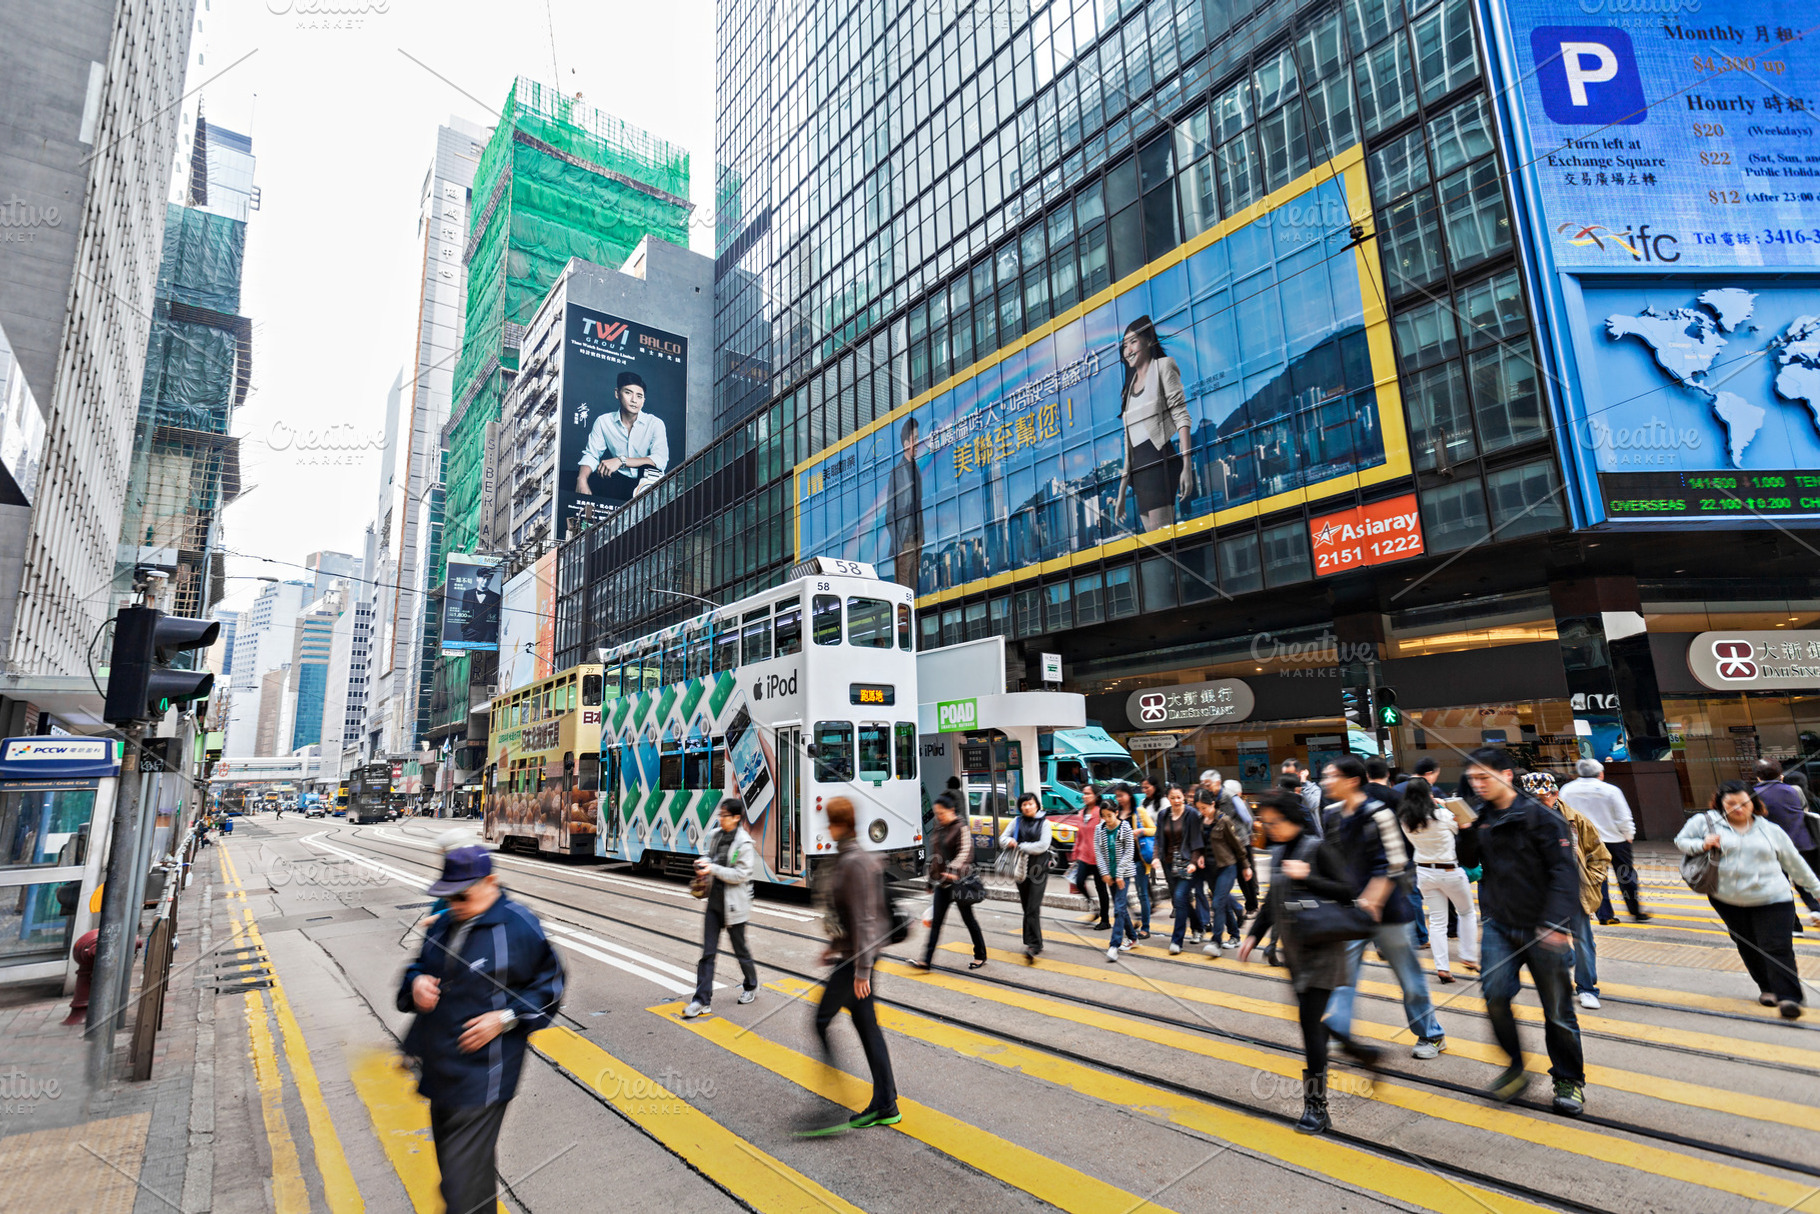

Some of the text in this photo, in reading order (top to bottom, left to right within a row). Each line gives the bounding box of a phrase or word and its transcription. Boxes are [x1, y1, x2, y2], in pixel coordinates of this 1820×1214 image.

[1664, 25, 1744, 44] Monthly
[1560, 42, 1618, 106] P
[1763, 60, 1786, 76] up
[1686, 95, 1755, 115] Hourly
[1693, 122, 1813, 138] $20 (Weekdays)
[1563, 137, 1641, 150] Turn left at
[1548, 155, 1666, 169] Exchange Square
[1700, 150, 1731, 166] $22
[1805, 155, 1820, 163] an
[1564, 172, 1658, 186] 交易廣場左轉
[1745, 167, 1780, 177] Public
[1709, 189, 1741, 205] $12
[1746, 192, 1780, 204] (After
[1783, 192, 1814, 202] 23:00
[1626, 224, 1681, 262] ifc
[1693, 232, 1717, 244] Tel
[586, 336, 625, 351] GROUP
[639, 334, 681, 354] BALCO
[1610, 499, 1687, 512] OVERSEAS
[1341, 512, 1418, 542] Asiaray
[1318, 534, 1421, 568] 2151 1222
[836, 560, 862, 576] 58
[817, 582, 830, 591] 58
[766, 669, 797, 700] iPod
[1167, 687, 1234, 707] 大新銀行
[940, 702, 975, 725] POAD
[918, 849, 925, 860] 58
